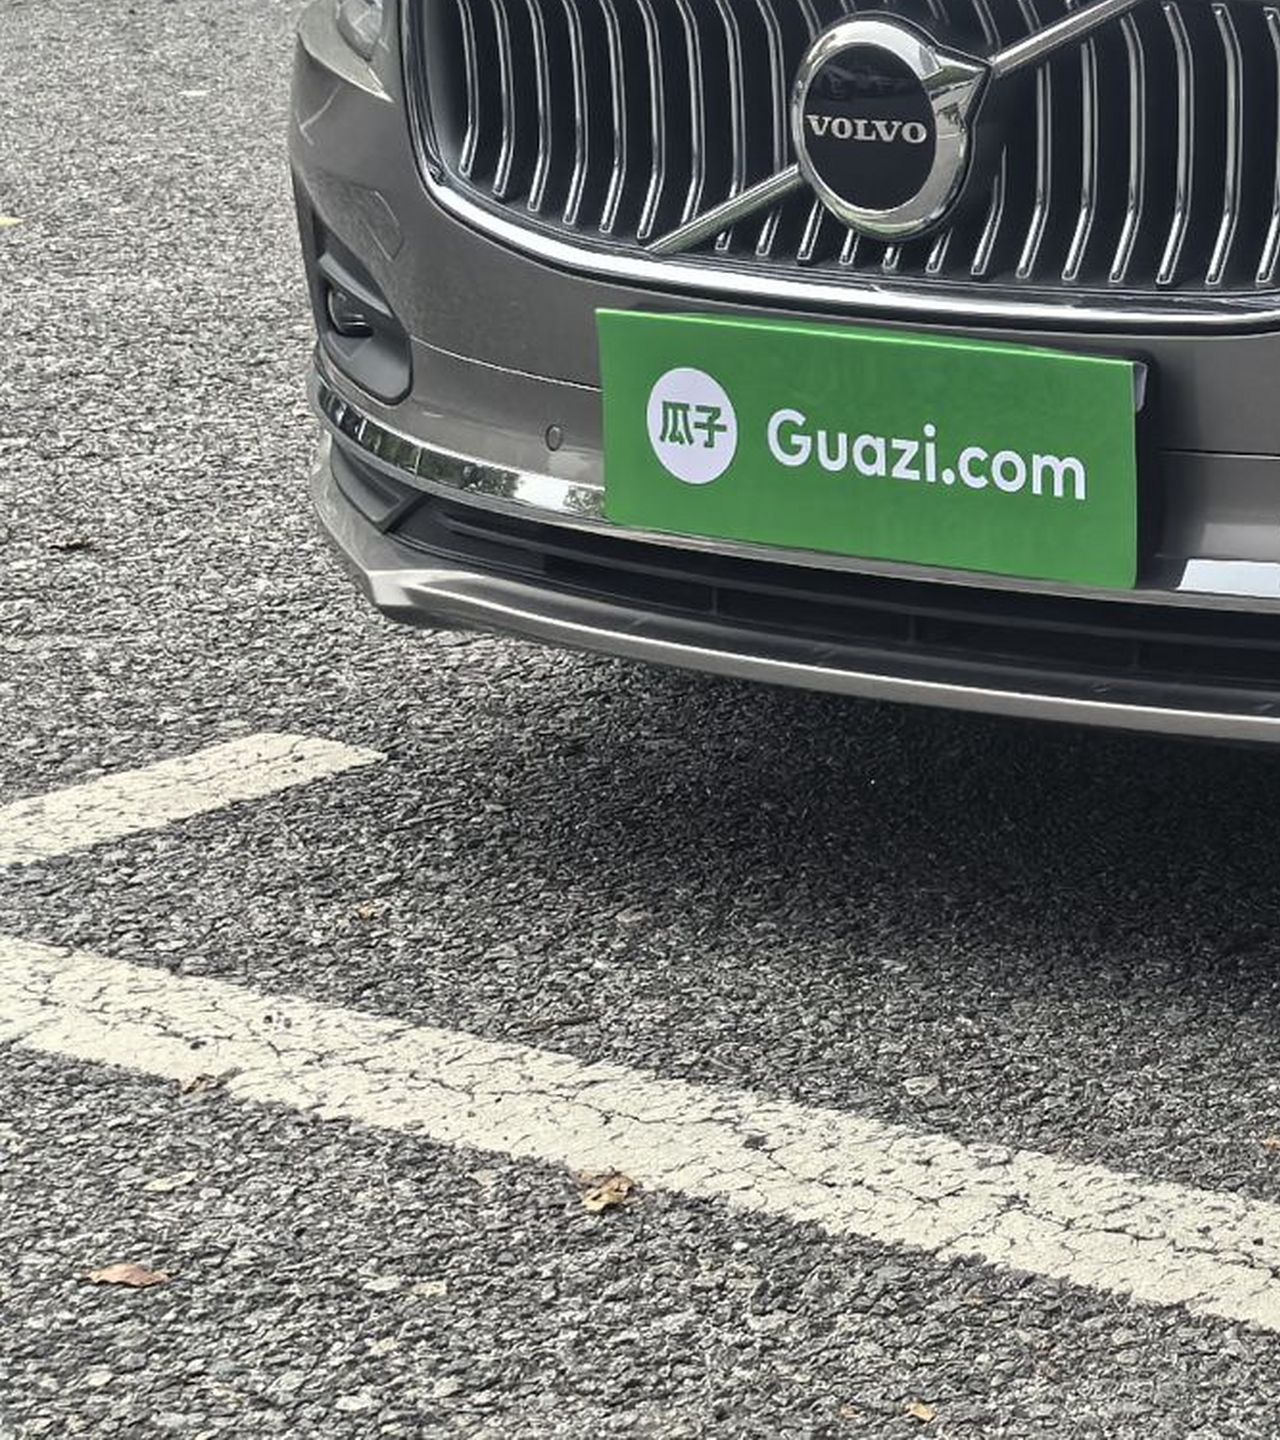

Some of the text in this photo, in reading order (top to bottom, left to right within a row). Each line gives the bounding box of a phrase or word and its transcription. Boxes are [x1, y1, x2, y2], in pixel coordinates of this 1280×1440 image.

[806, 114, 928, 144] VOLVO
[659, 401, 1086, 500] 瓜子 Guazi.com
